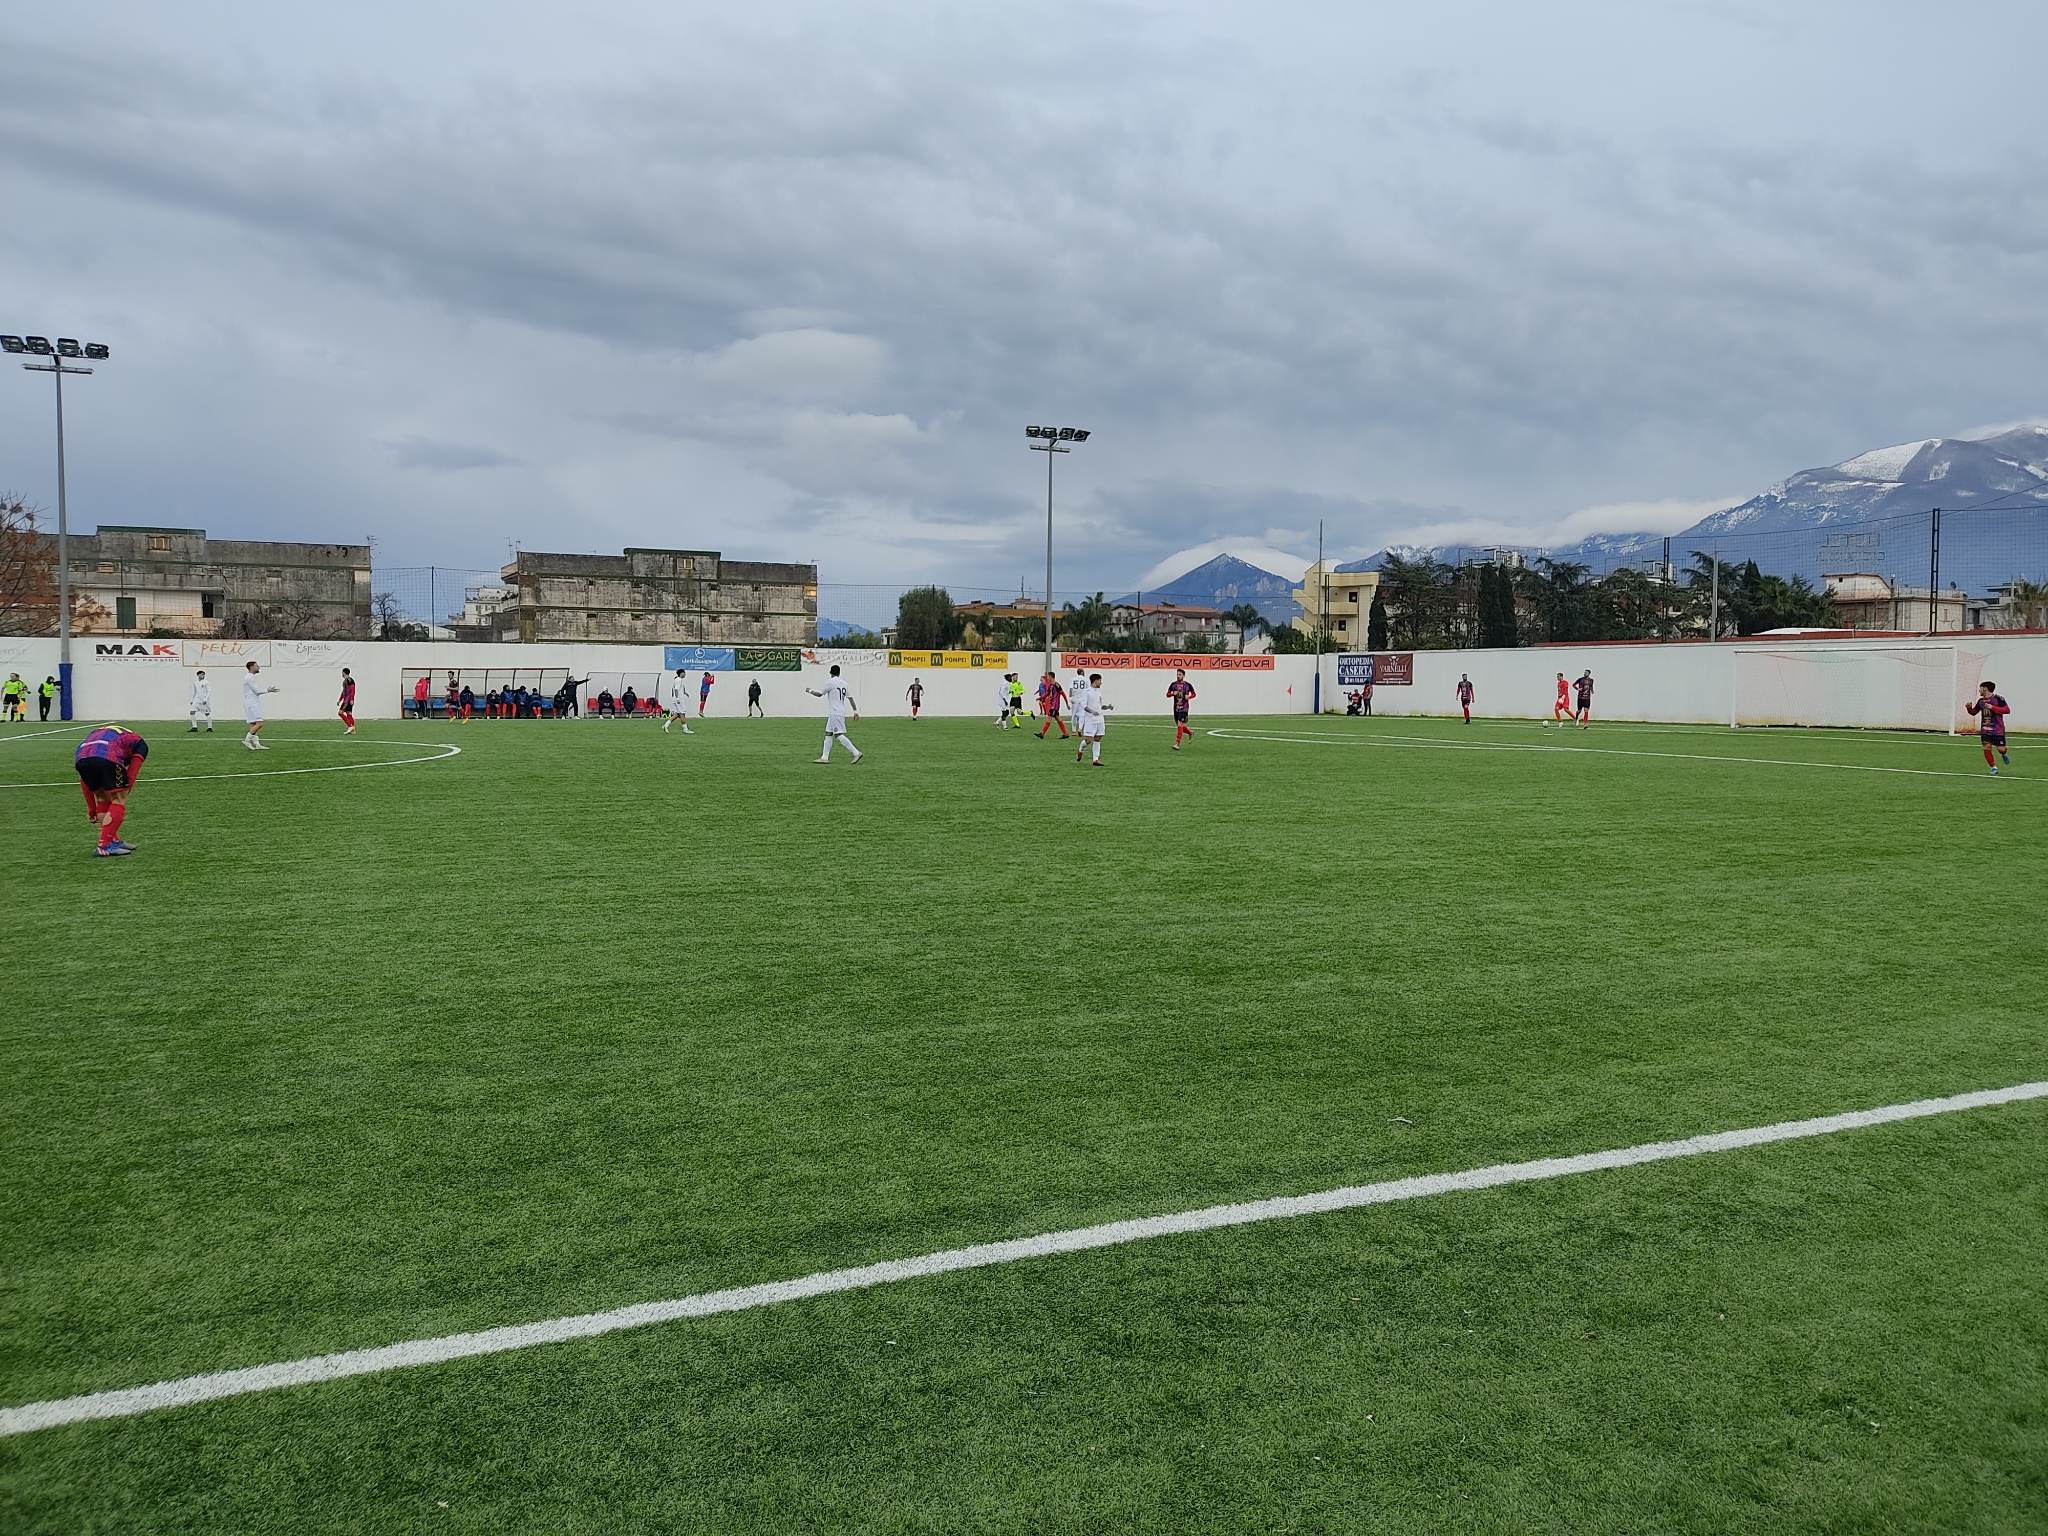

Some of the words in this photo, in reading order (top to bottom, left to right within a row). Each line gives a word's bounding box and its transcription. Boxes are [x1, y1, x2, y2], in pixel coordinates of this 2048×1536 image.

[95, 644, 178, 656] MAK
[738, 652, 753, 661] LA
[767, 651, 797, 661] GARE
[1077, 657, 1130, 666] GIVOVA
[1151, 658, 1202, 667] GIVOVA
[1220, 659, 1270, 668] GIVOVA
[1339, 657, 1374, 666] ORTOPEDIA
[1339, 665, 1373, 675] CASERTA
[1073, 680, 1086, 690] 58
